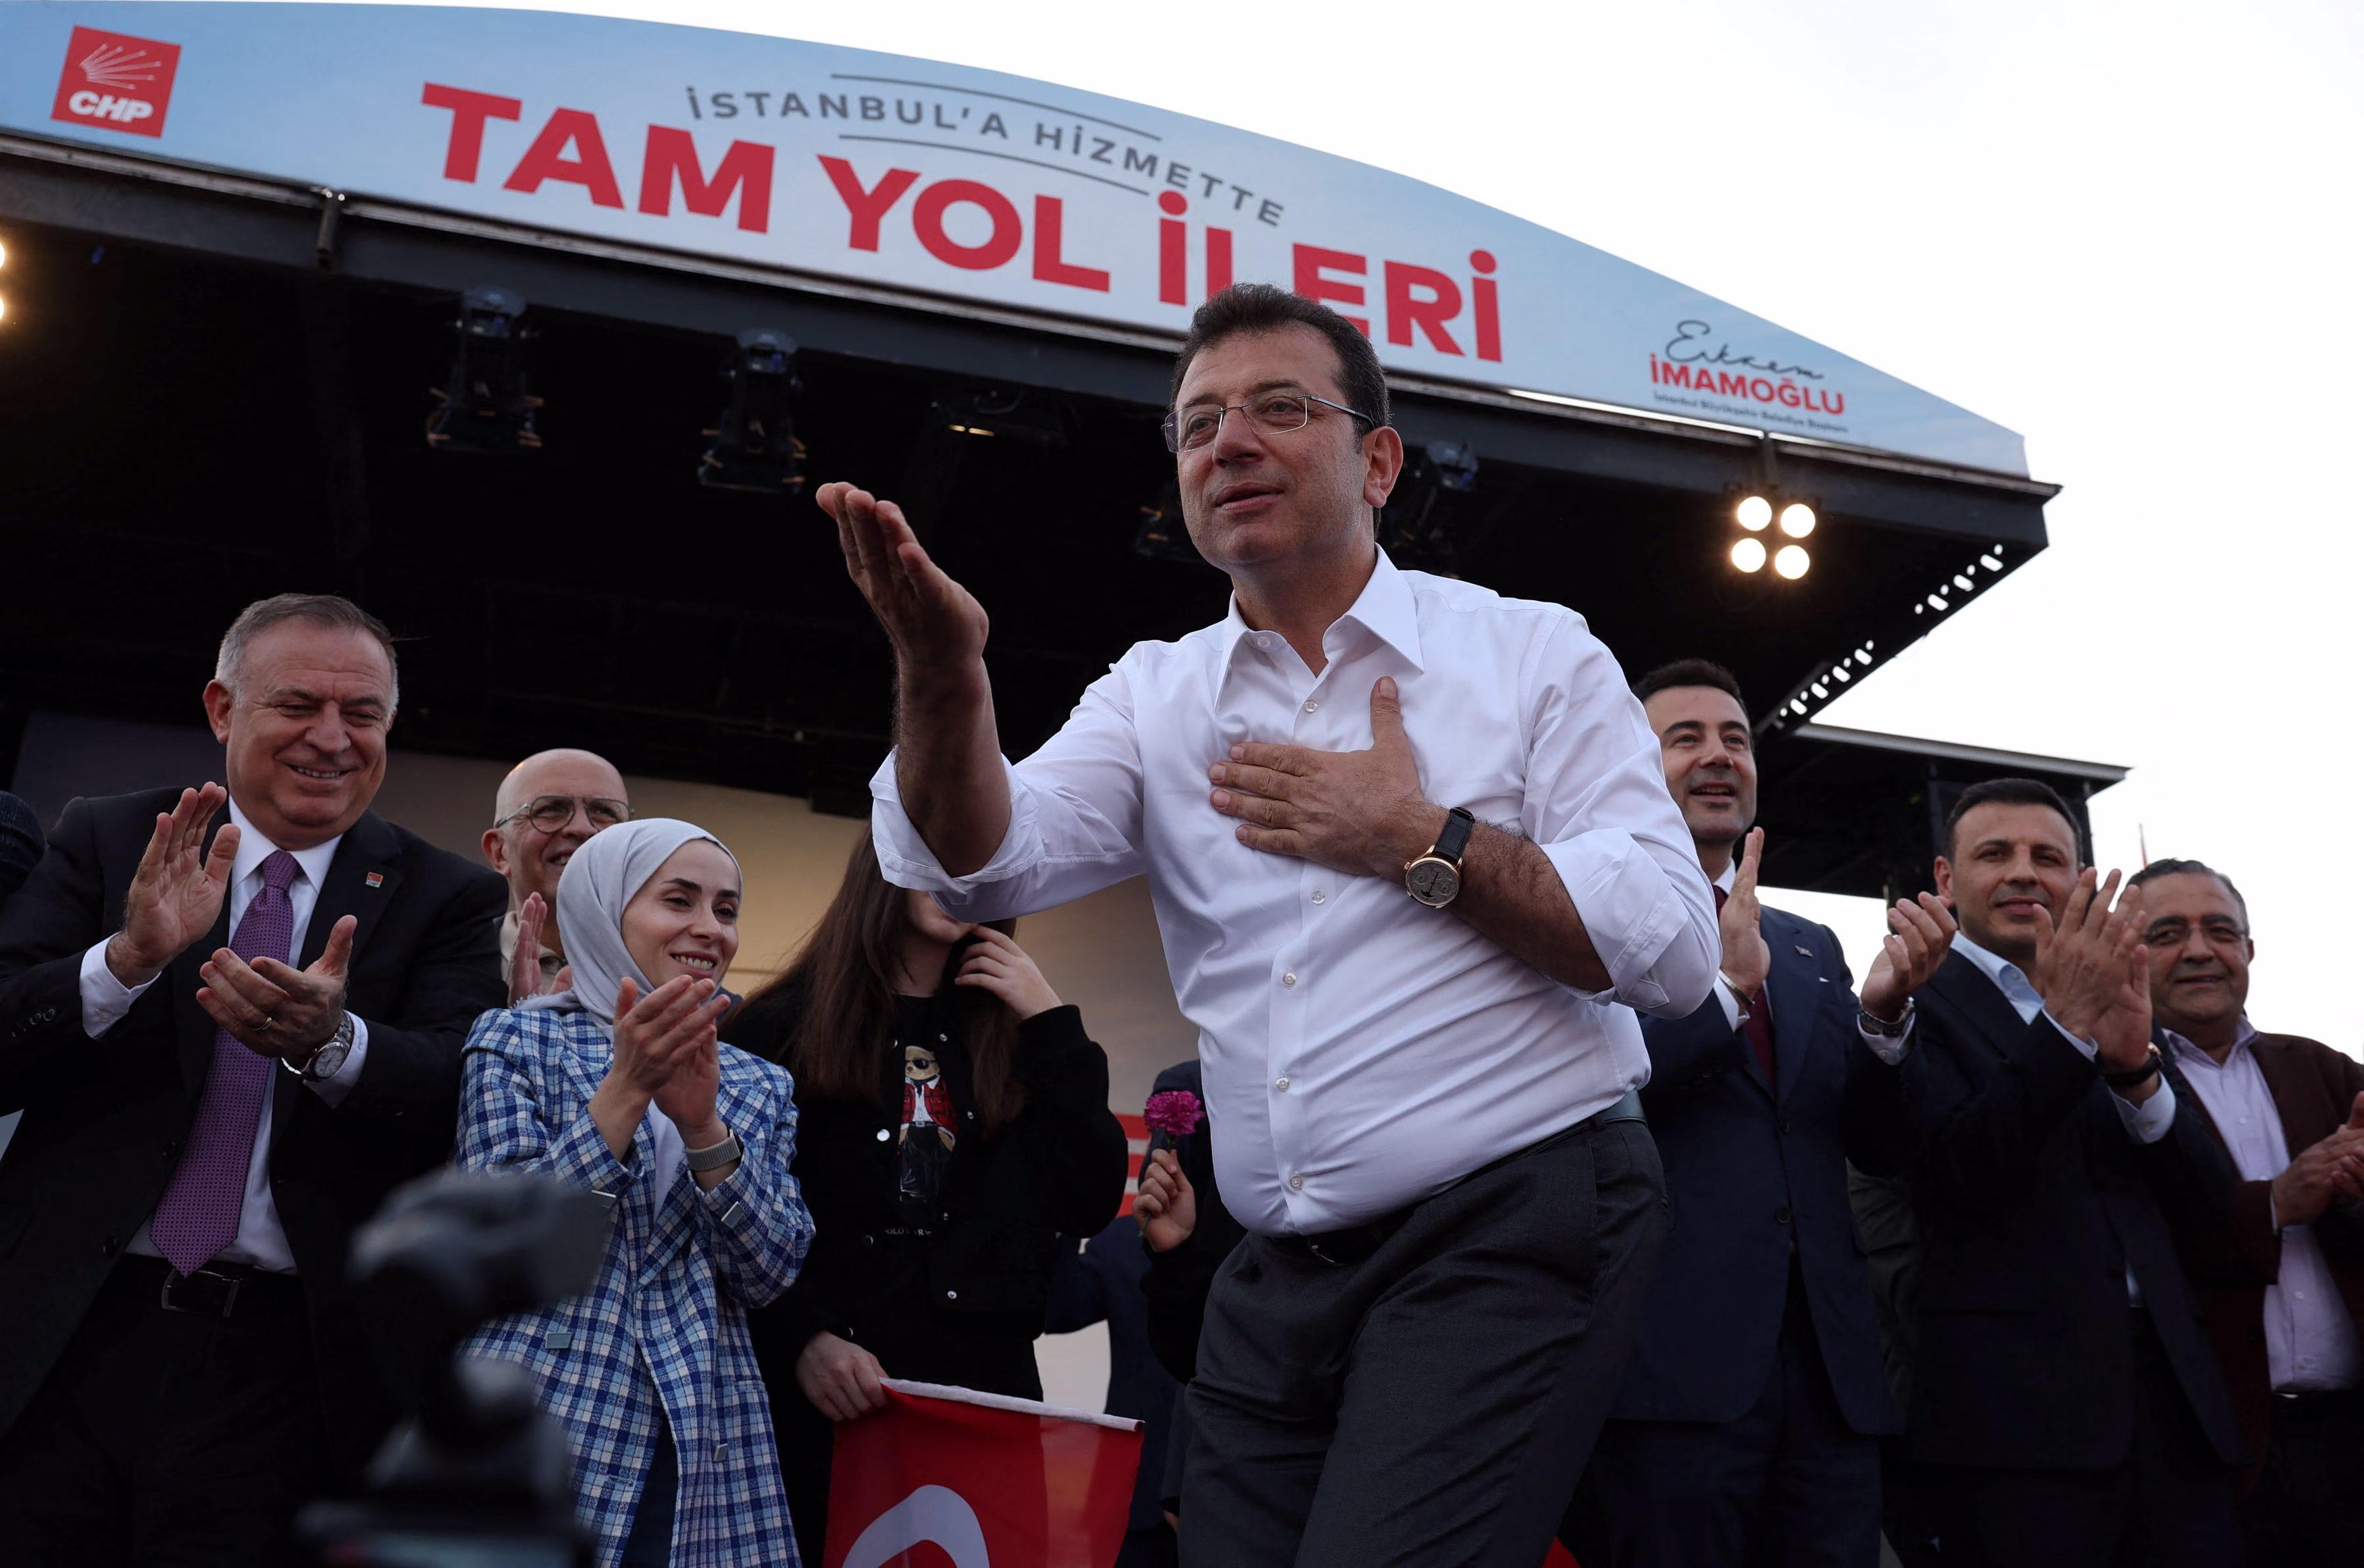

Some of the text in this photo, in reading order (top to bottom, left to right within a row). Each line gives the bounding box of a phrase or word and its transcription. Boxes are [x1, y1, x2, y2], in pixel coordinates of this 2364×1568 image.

[68, 89, 154, 124] CHP
[421, 82, 775, 234] TAM
[817, 154, 1110, 293] YOL
[686, 86, 1284, 228] İSTANBUL'A HİZMETTE
[1649, 352, 1845, 416] İMAMOĞLU
[885, 1227, 904, 1235] OLO
